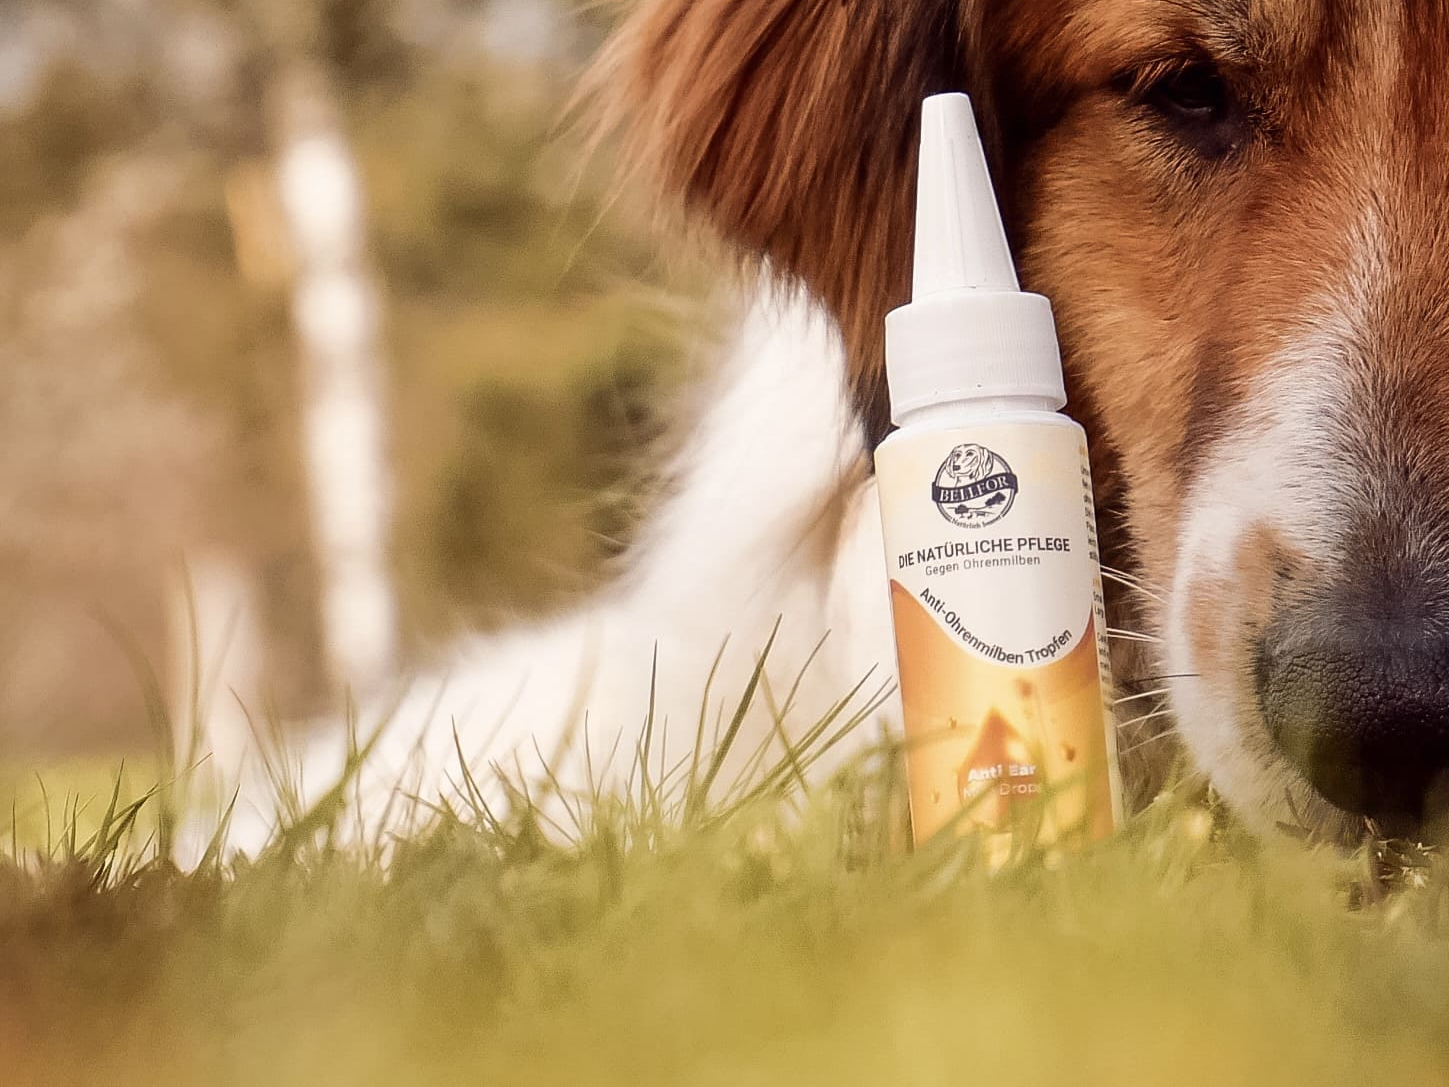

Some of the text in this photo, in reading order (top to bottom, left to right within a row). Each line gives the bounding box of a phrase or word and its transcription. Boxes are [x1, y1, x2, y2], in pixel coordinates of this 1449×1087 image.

[939, 476, 1009, 502] BELLFOR
[899, 537, 1071, 569] DIE NATÜRLICHE PFLEGE
[925, 555, 1041, 576] Gegen Ohrenmilben
[920, 587, 1073, 664] Anti-Ohrenmilben Tropfen
[968, 764, 1037, 782] Anti Ear
